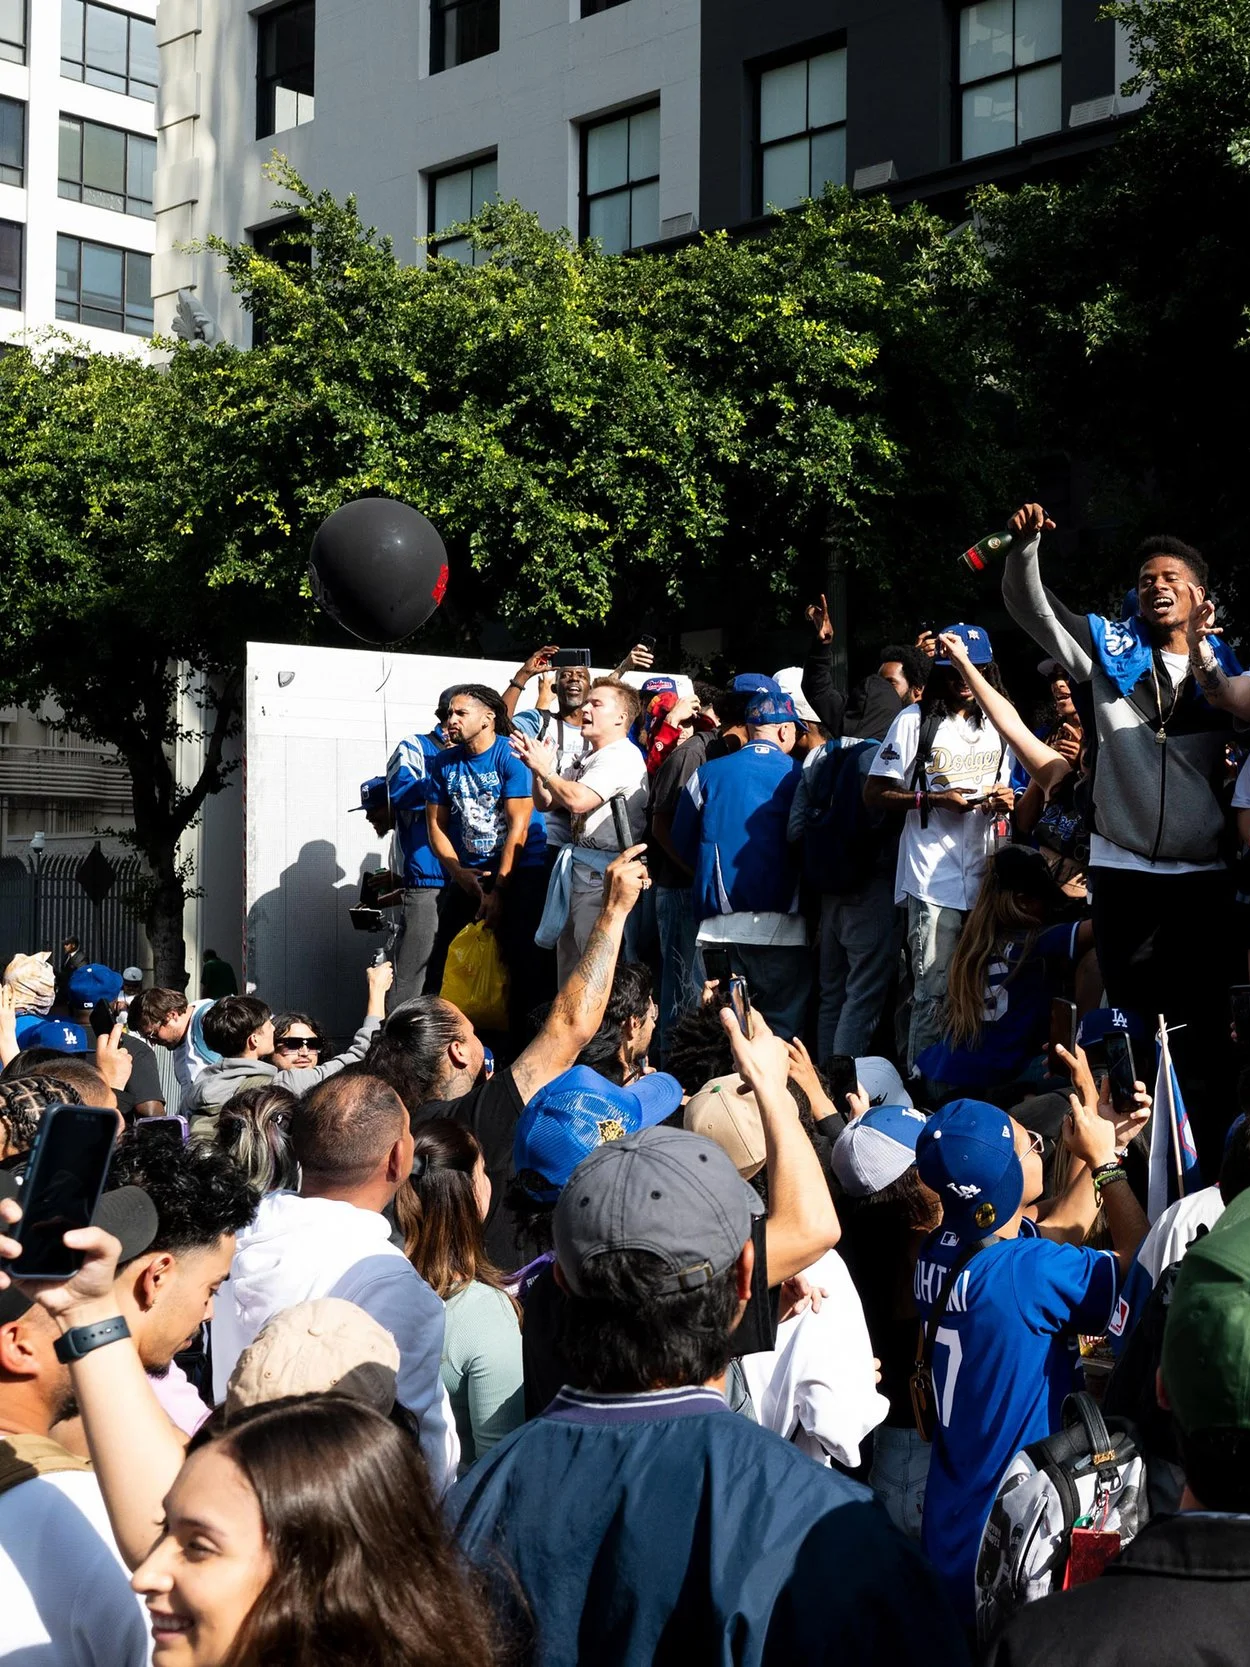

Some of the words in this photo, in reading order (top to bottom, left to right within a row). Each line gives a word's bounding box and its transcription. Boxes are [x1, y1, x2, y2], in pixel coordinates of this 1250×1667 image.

[926, 745, 1001, 785] Dodger
[1111, 1008, 1128, 1028] LA
[63, 1028, 78, 1044] LA
[947, 1182, 981, 1199] LA
[914, 1259, 971, 1312] OHTNI
